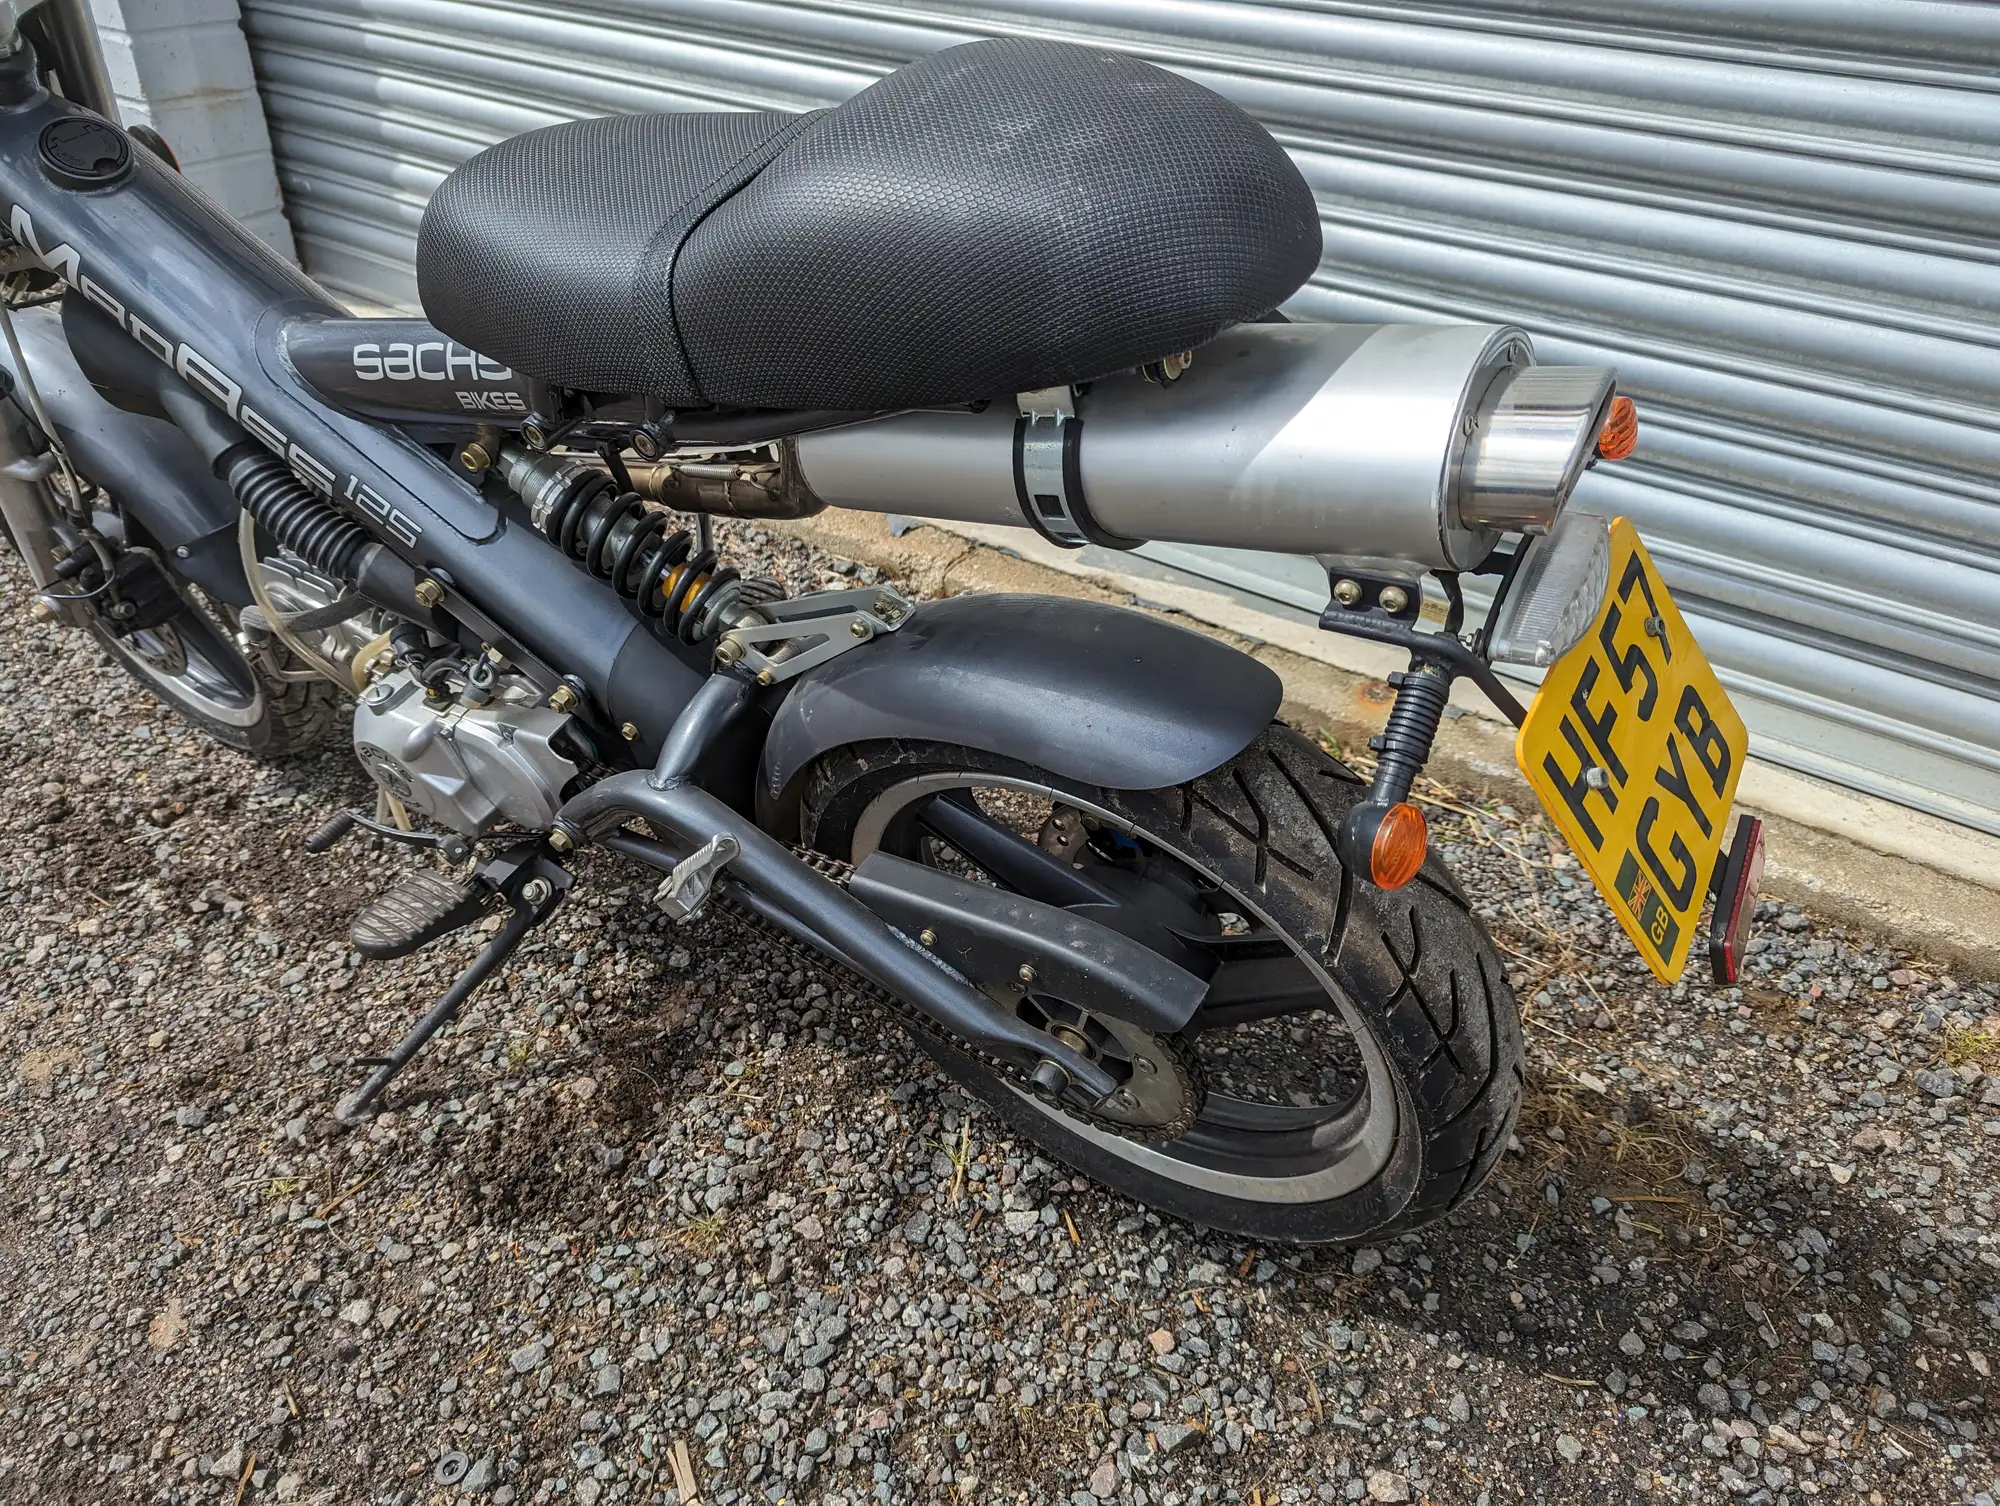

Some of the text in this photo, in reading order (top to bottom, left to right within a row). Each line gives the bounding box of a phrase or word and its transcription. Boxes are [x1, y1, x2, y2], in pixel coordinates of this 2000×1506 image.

[454, 391, 528, 411] BIKES
[344, 473, 423, 550] 125
[1542, 549, 1673, 853] HF57
[1635, 684, 1732, 913] GYB
[1650, 905, 1669, 946] GB
